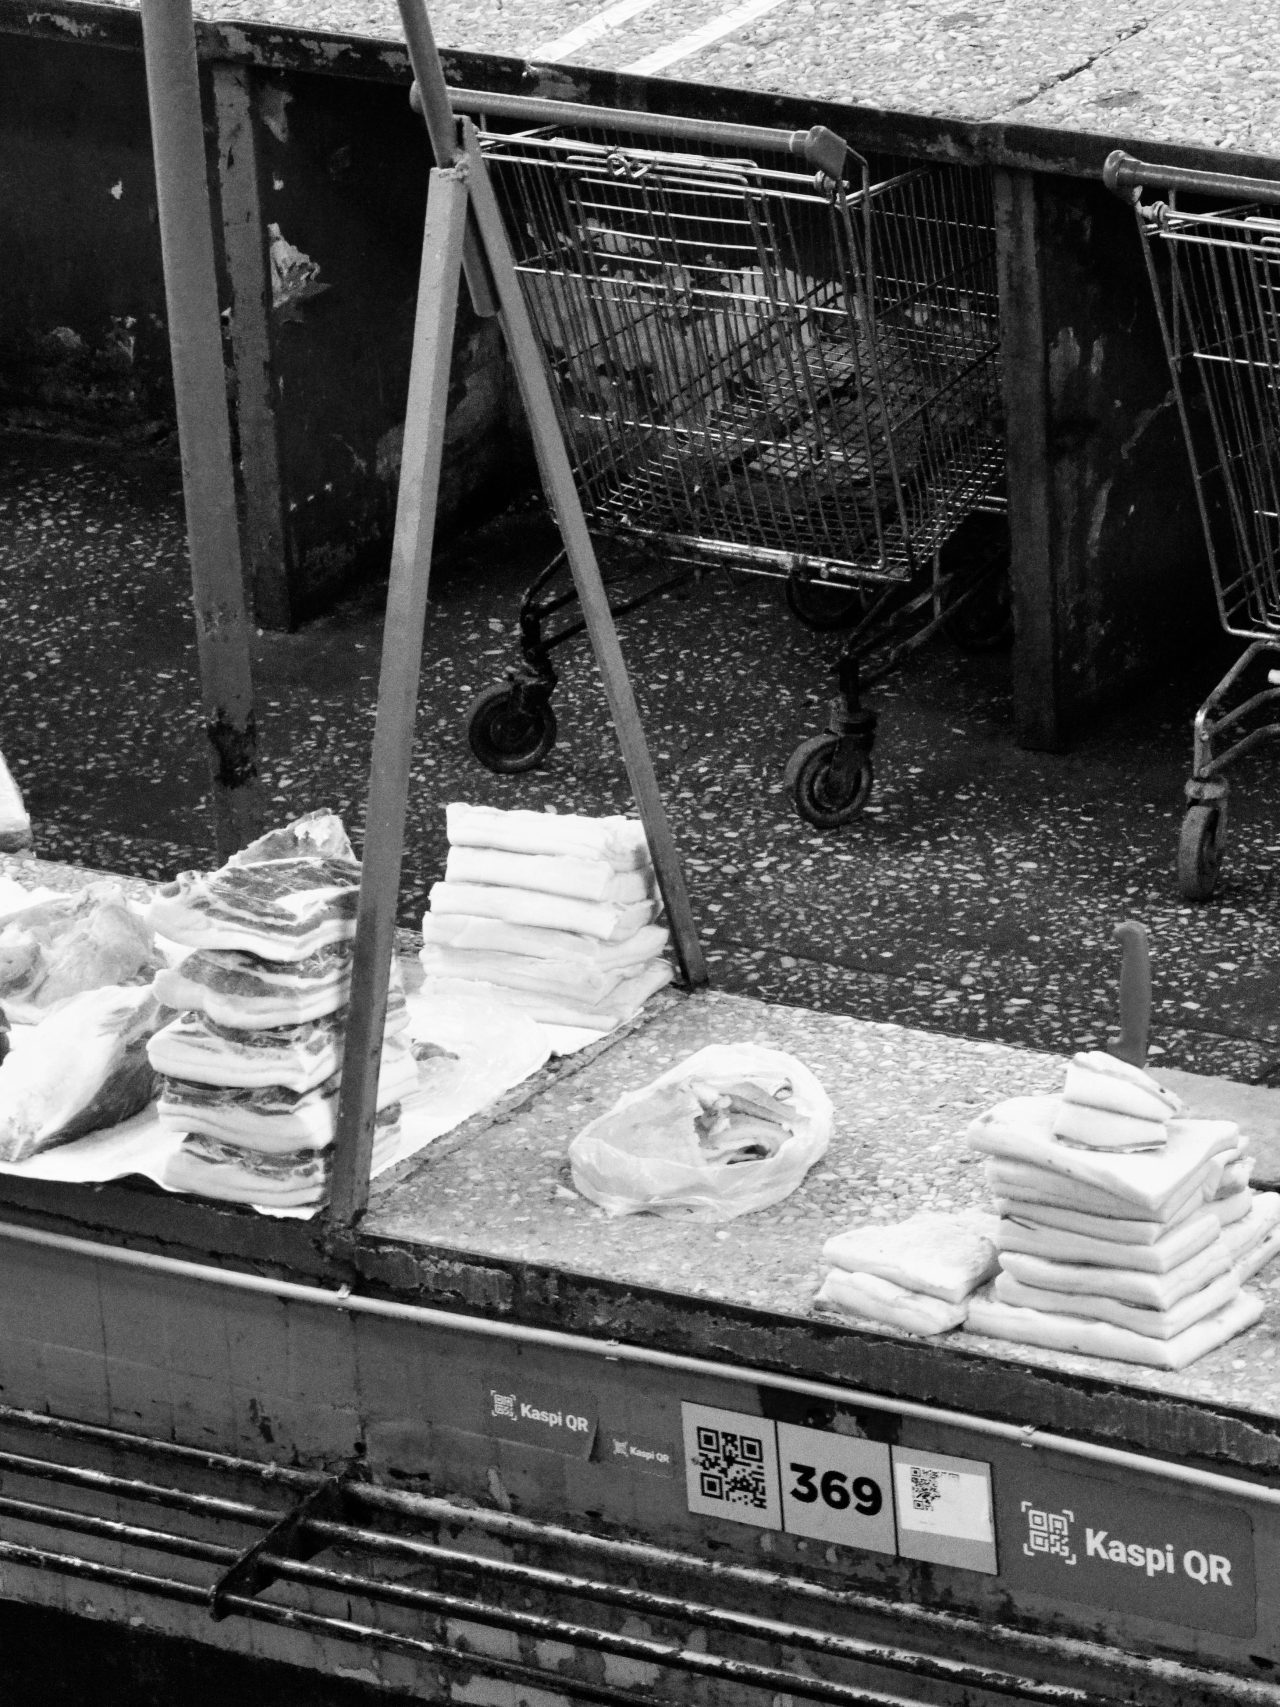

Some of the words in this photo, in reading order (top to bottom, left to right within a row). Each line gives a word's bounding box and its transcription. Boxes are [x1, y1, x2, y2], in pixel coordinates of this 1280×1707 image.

[521, 1402, 563, 1428] Kaspi
[566, 1414, 589, 1433] QR
[630, 1446, 655, 1461] Kaspi
[656, 1451, 670, 1464] QR
[790, 1462, 883, 1517] 369
[1085, 1527, 1175, 1577] Kaspi
[1183, 1549, 1233, 1587] QR
